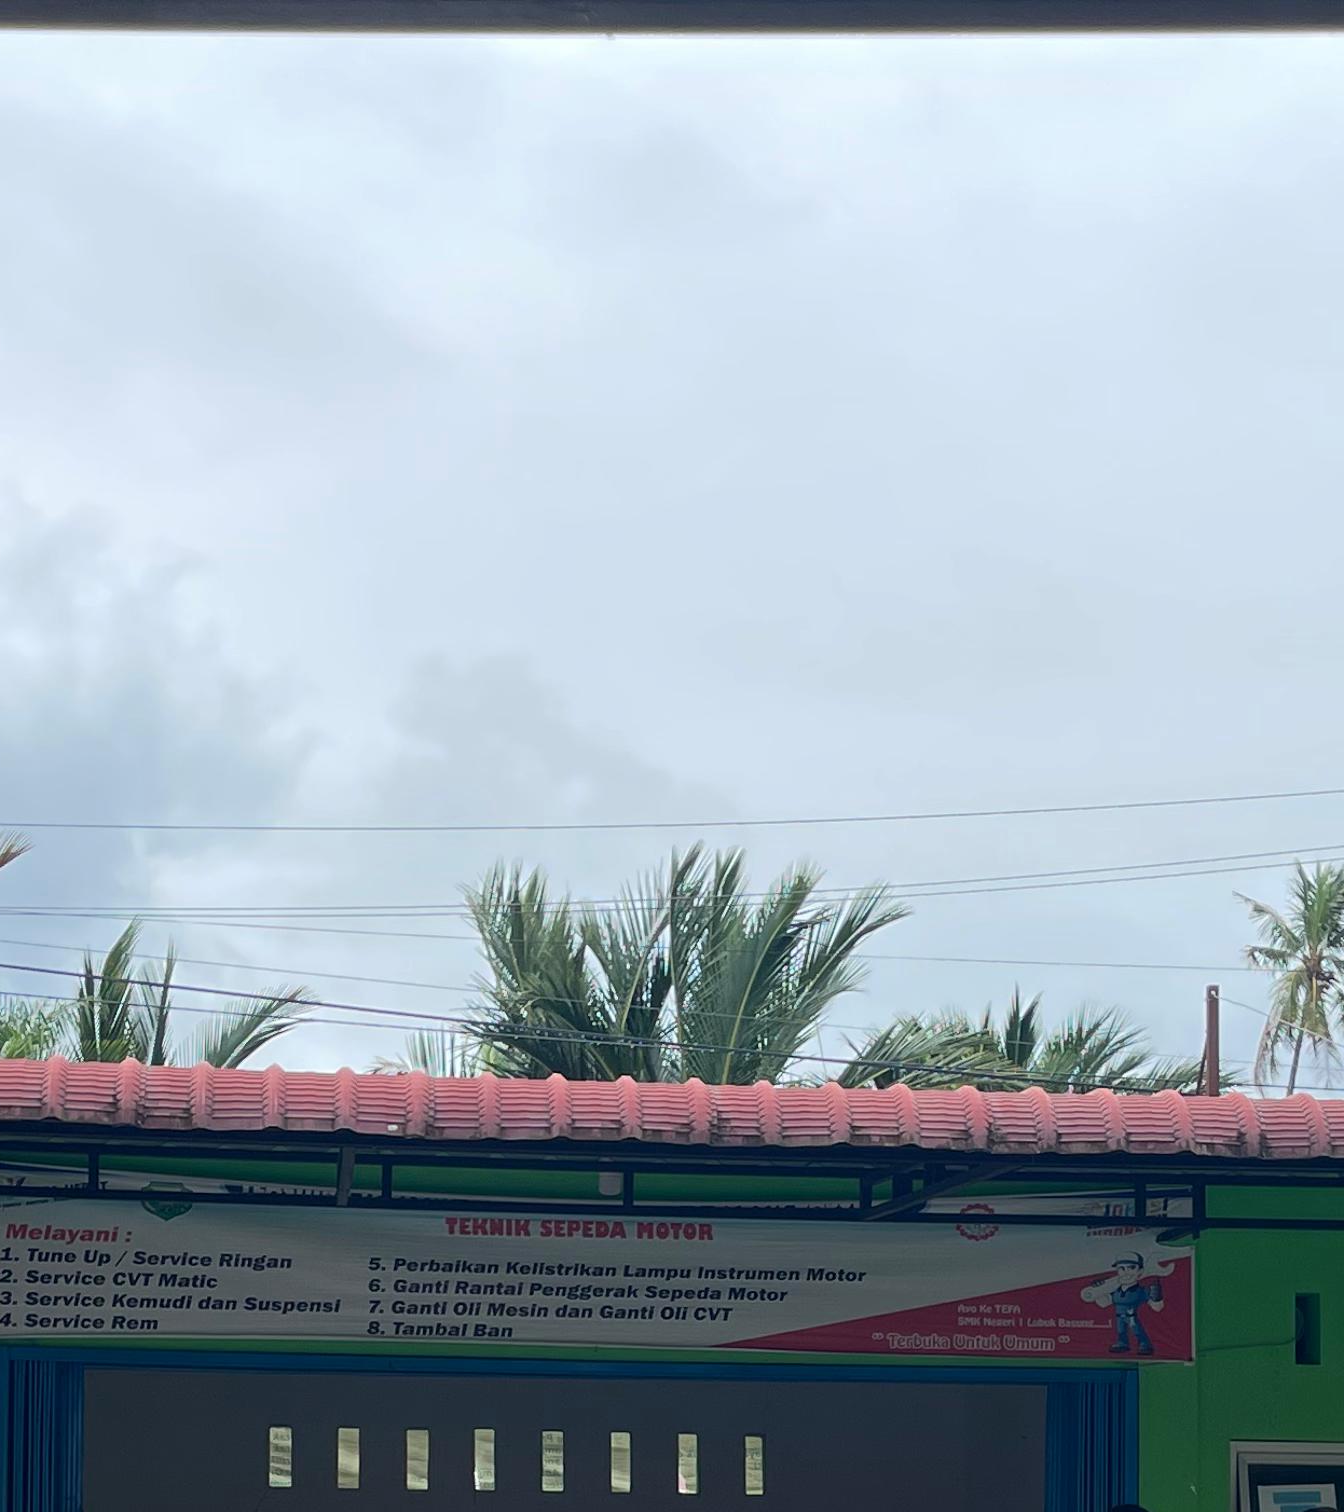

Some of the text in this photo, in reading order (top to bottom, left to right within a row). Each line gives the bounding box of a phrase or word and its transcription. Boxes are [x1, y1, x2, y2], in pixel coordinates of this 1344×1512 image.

[5, 1223, 119, 1244] Melayani
[444, 1217, 714, 1241] TEKNIK SEPEDA MOTOR
[0, 1247, 20, 1262] 1.
[27, 1248, 78, 1264] Tune
[83, 1249, 111, 1267] Up
[132, 1251, 213, 1267] Service
[218, 1254, 293, 1271] Ringan
[368, 1257, 866, 1282] 5. Perbaikan Kelistrikan Lampu Instrumen Motor
[24, 1270, 106, 1286] Service
[112, 1272, 154, 1287] CVT
[158, 1273, 218, 1288] Matic
[368, 1279, 788, 1303] 6. Ganti Rantai Penggerak Sepeda Motor
[24, 1292, 106, 1308] Service
[111, 1293, 193, 1310] Kemudi
[198, 1296, 238, 1312] dan
[243, 1297, 341, 1314] Suspensi
[368, 1300, 733, 1322] 7. Ganti Oli Mesin dan Ganti Oli CVT
[24, 1314, 104, 1330] Service
[110, 1315, 158, 1330] Rem
[367, 1322, 514, 1338] 8. Tambal Ban
[958, 1317, 980, 1326] SMK
[886, 1333, 950, 1350] Terbuka
[953, 1335, 1001, 1350] Untuk
[1003, 1336, 1056, 1351] Umum
